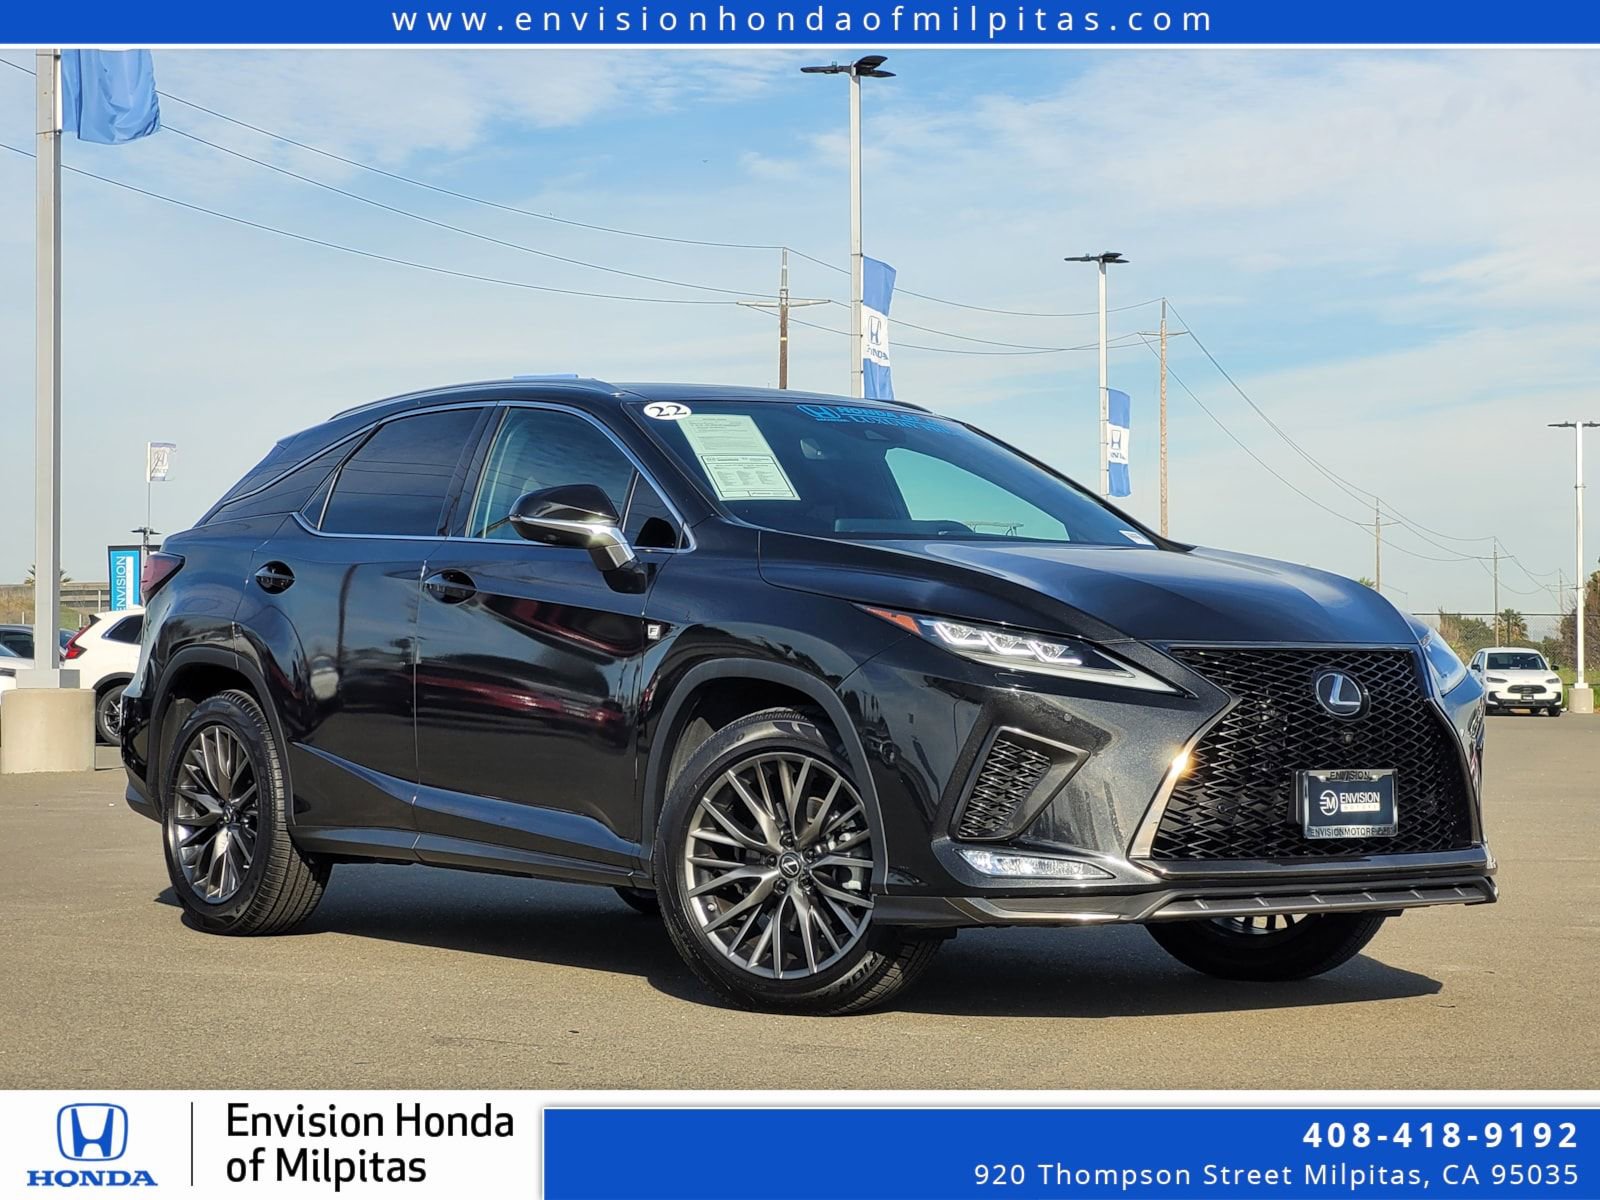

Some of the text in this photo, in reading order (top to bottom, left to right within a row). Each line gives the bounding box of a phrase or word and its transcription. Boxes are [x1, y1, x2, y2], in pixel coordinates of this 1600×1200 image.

[649, 404, 688, 417] 22
[1329, 770, 1371, 781] ENVISION
[1340, 792, 1380, 804] ENVISION
